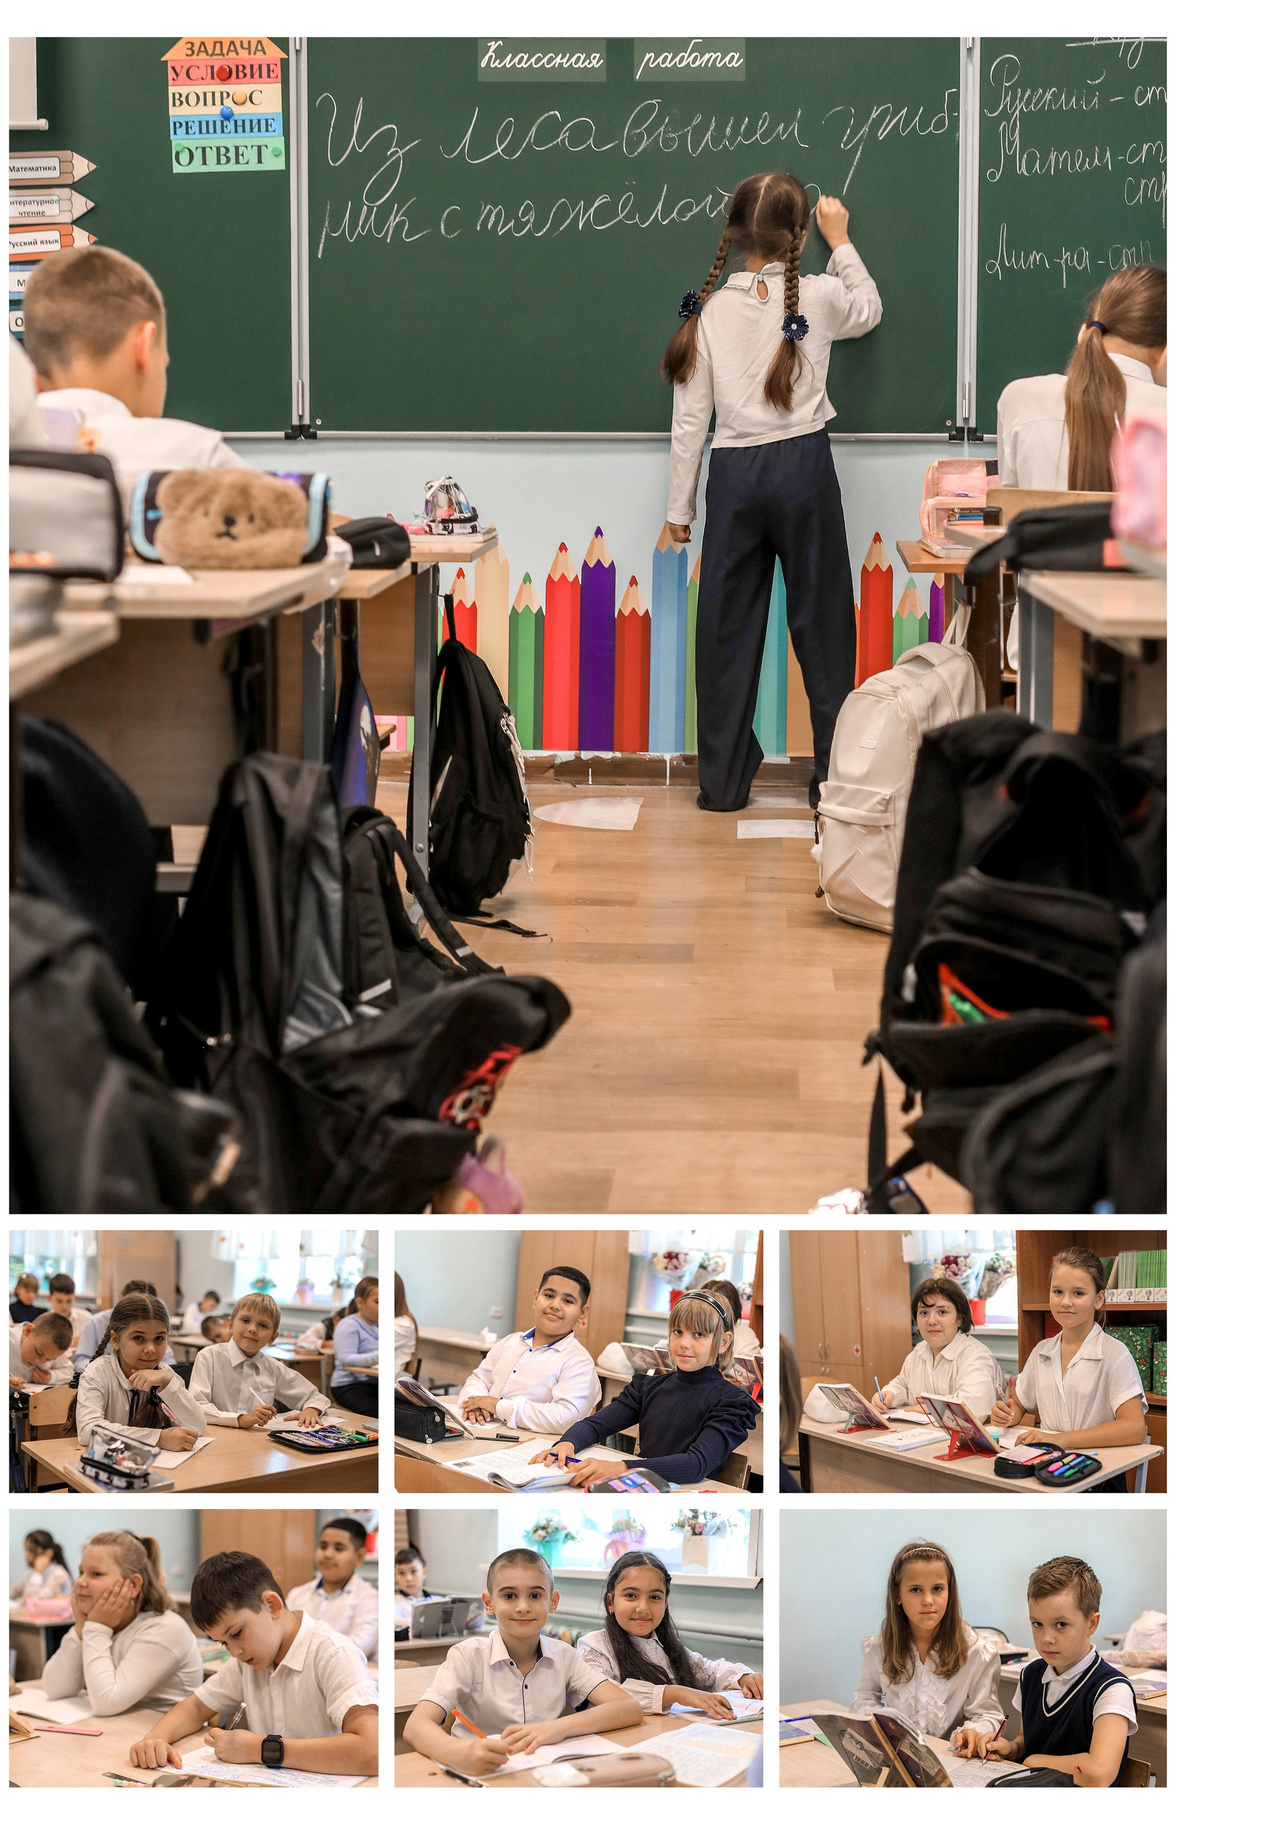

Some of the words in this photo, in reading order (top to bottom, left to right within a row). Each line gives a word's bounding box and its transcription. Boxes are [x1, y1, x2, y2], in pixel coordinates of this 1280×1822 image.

[185, 39, 267, 57] ЗАДАЧА
[480, 40, 604, 69] Классная
[636, 39, 744, 80] работа
[171, 89, 263, 108] ВОПРС
[984, 54, 1107, 141] Русский
[171, 118, 277, 136] РЕШЕНИЕ
[174, 144, 269, 168] ОТВЕТ
[316, 92, 421, 206] Из
[439, 106, 620, 164] леса
[9, 165, 57, 173] Математика
[9, 199, 60, 208] итературное
